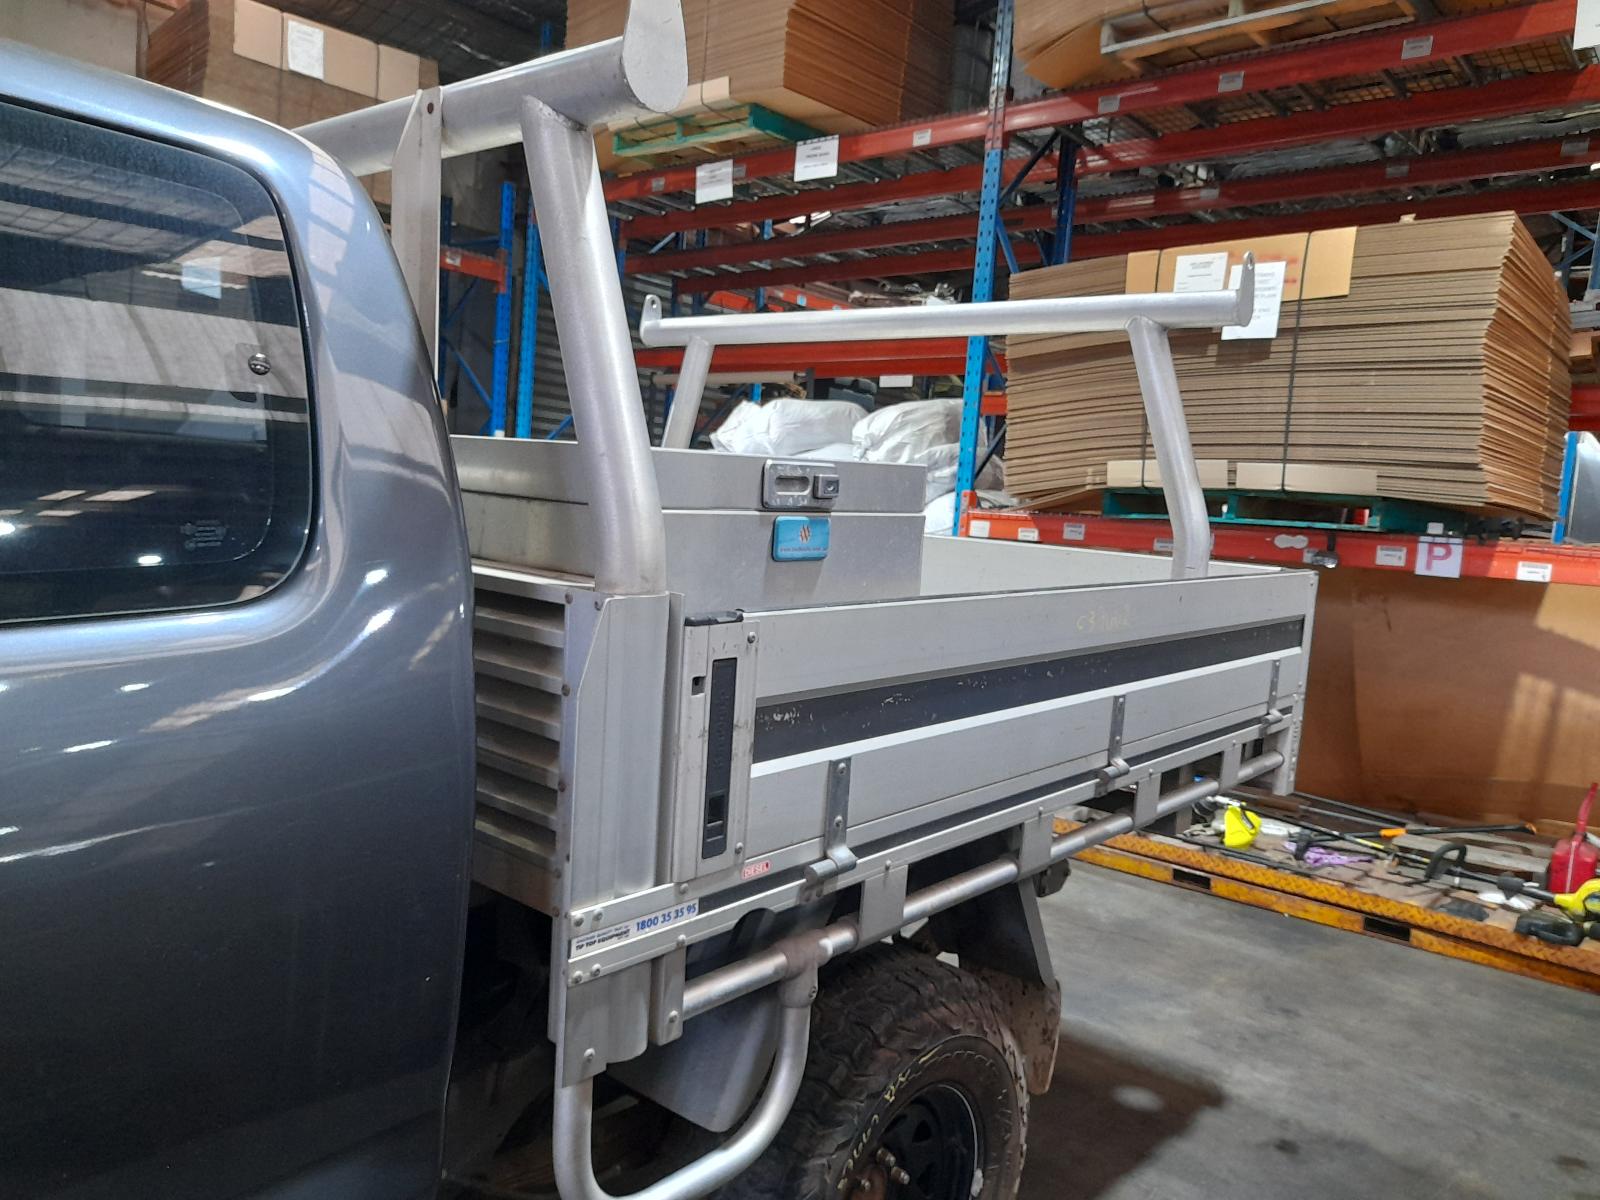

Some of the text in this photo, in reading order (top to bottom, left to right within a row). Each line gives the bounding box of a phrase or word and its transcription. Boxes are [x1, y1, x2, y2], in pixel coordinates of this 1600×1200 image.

[1425, 543, 1453, 571] P
[636, 902, 697, 931] 1800 35 35 95
[586, 939, 597, 947] TOP
[597, 928, 630, 943] EQUIPMENT
